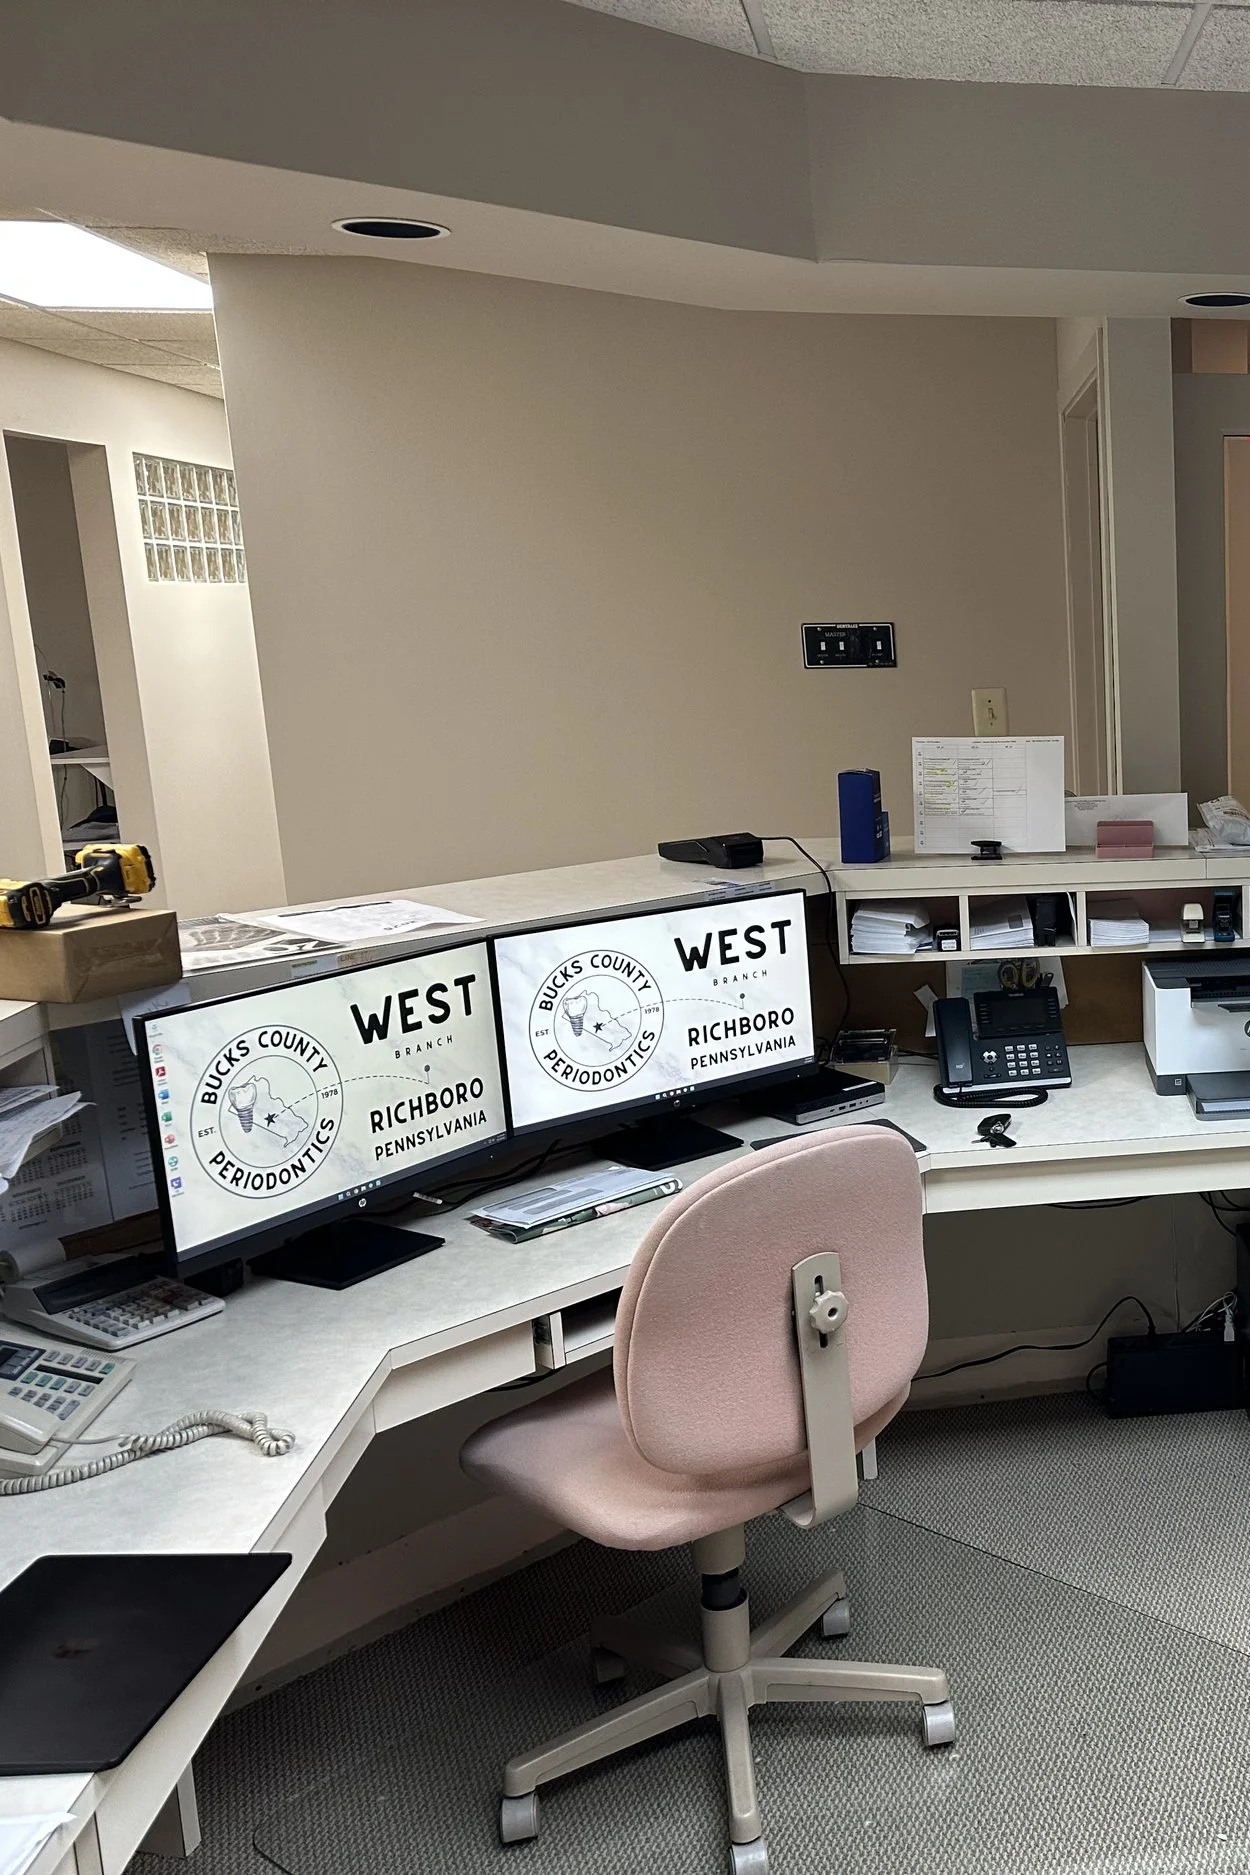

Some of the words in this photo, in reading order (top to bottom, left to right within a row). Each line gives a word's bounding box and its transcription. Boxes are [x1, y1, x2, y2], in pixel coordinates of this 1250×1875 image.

[674, 919, 792, 972] WEST
[539, 960, 583, 1012] BUCKS
[590, 954, 651, 992] COUNTY
[713, 970, 768, 987] BRANCH
[350, 974, 476, 1045] WEST
[644, 1006, 660, 1015] 1978
[687, 1007, 794, 1048] RICHBORO
[201, 1039, 251, 1105] BUCKS
[258, 1030, 328, 1074] COUNTY
[395, 1035, 454, 1059] BRANCH
[543, 1030, 656, 1086] PERIODONTICS
[690, 1035, 796, 1070] PENNSYLVANIA
[321, 1088, 339, 1100] 1978
[370, 1077, 484, 1134] RICHBORO
[198, 1126, 217, 1138] EST.
[209, 1117, 335, 1191] PERIODONTICS
[375, 1110, 487, 1161] PENNSYLVANIA
